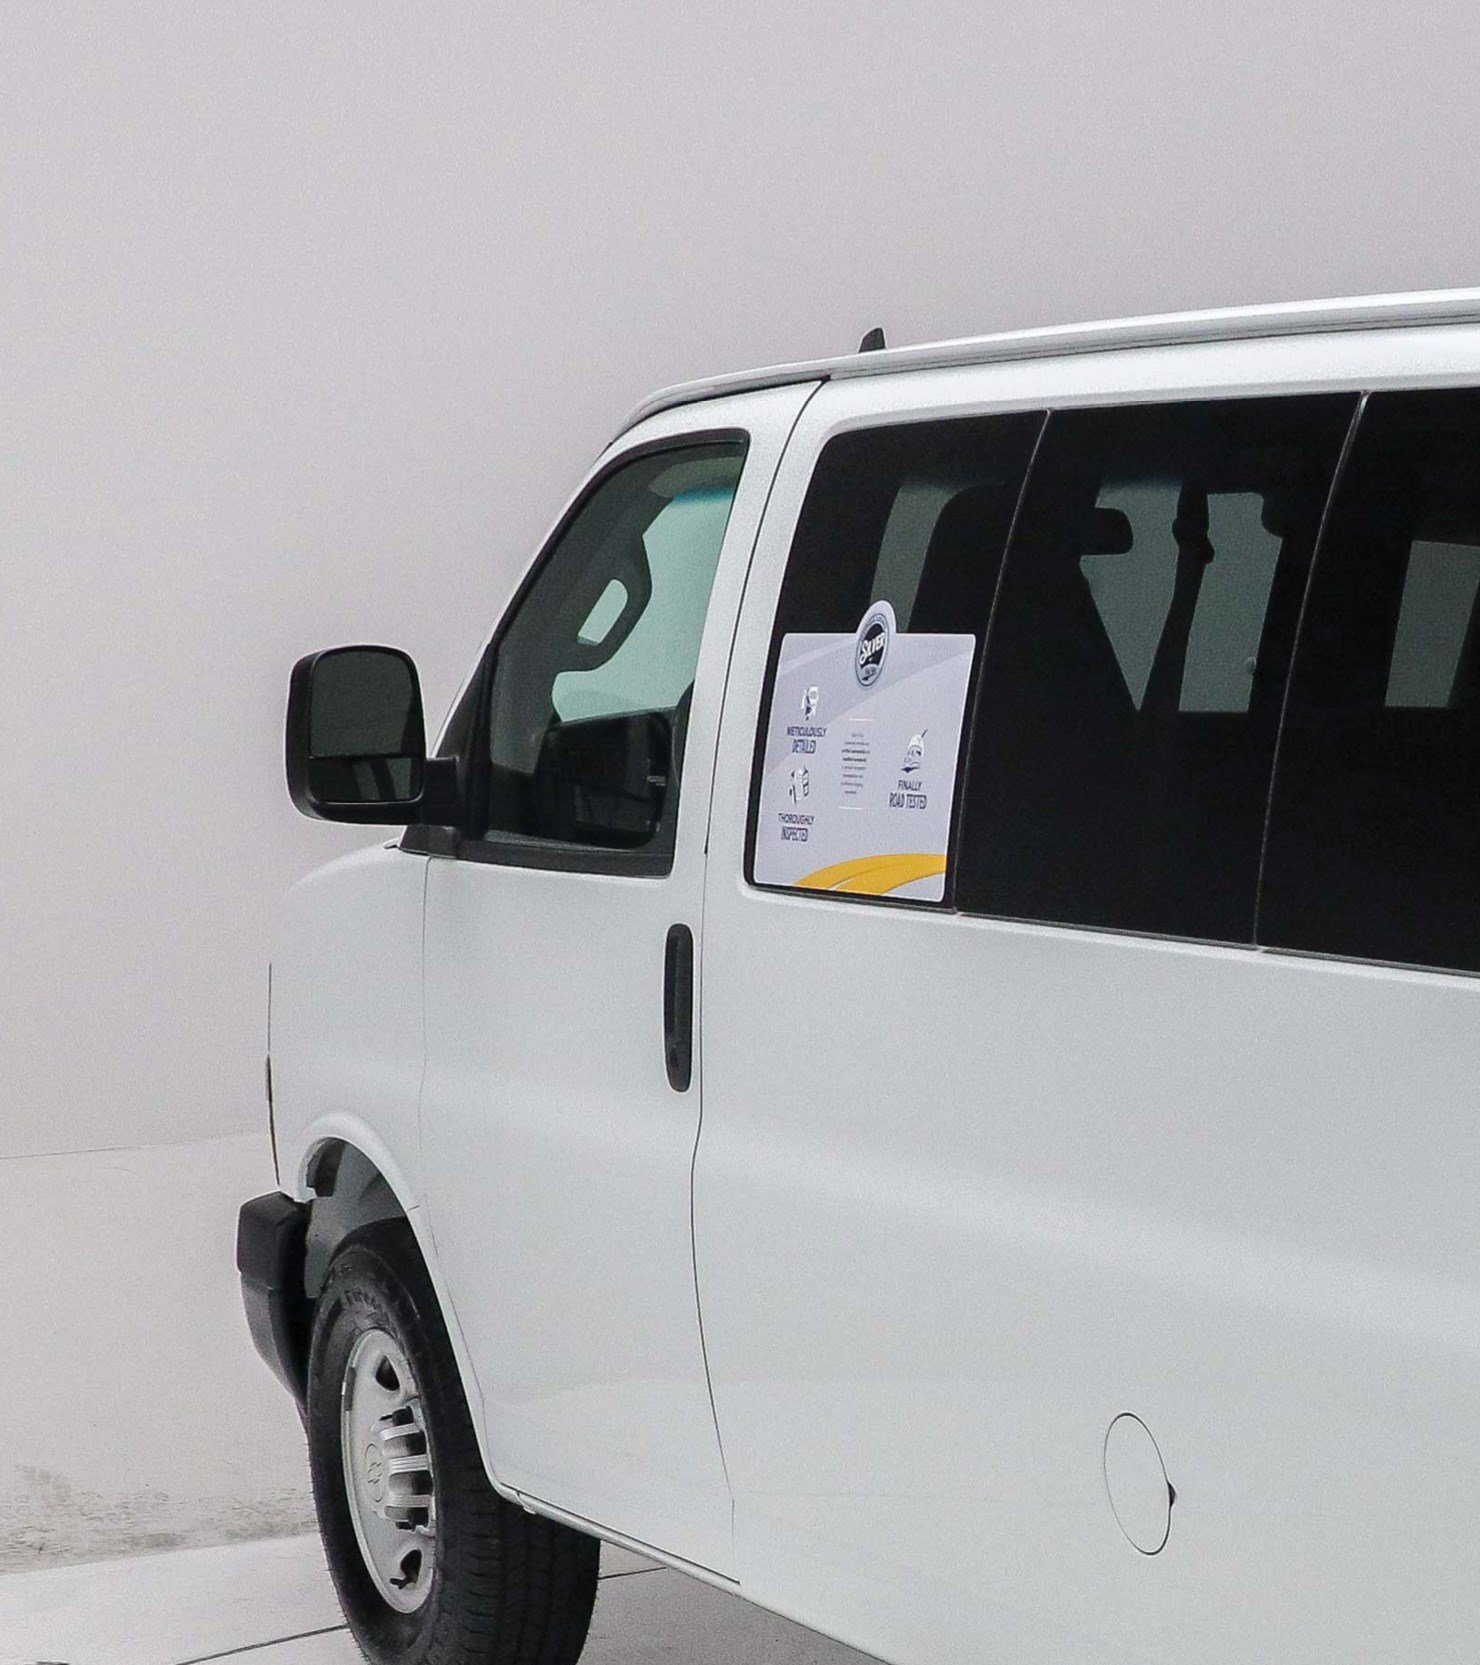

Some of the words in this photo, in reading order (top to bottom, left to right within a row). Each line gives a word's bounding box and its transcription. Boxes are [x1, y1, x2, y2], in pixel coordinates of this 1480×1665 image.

[786, 726, 828, 737] METICULOUSLY
[897, 780, 923, 791] FINALLY
[778, 813, 815, 825] THOROUGHLY
